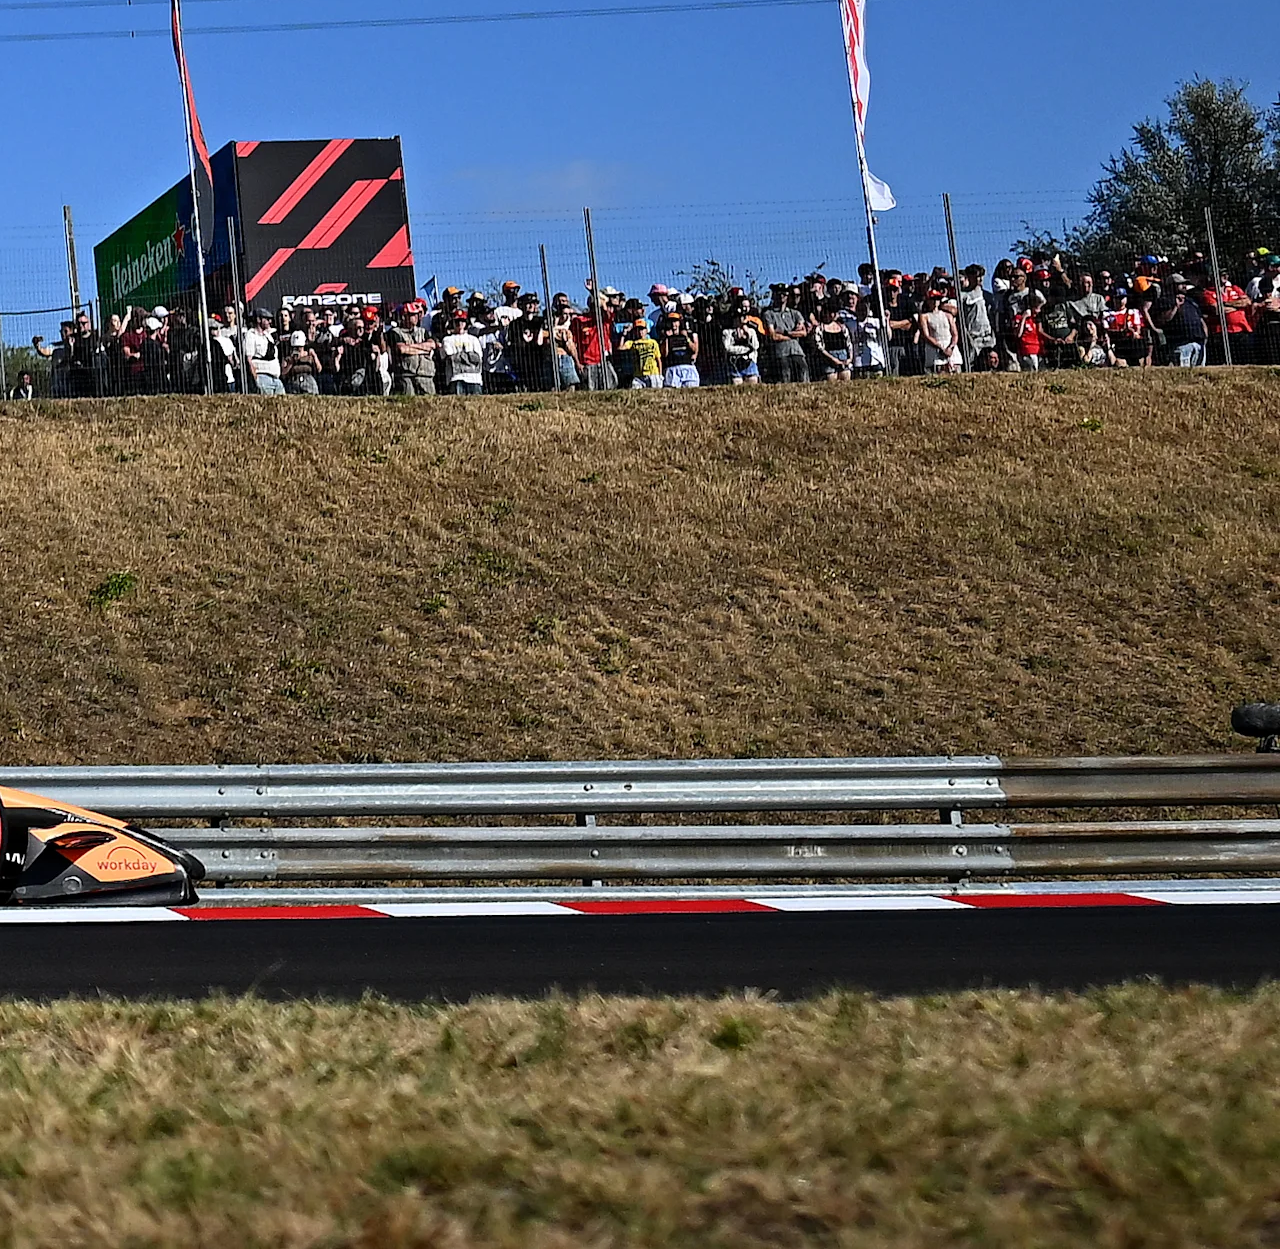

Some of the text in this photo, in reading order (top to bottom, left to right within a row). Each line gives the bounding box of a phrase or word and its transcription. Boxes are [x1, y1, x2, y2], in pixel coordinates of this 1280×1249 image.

[111, 236, 173, 303] Heineken
[282, 293, 382, 306] FANZONE
[97, 859, 157, 873] workday
